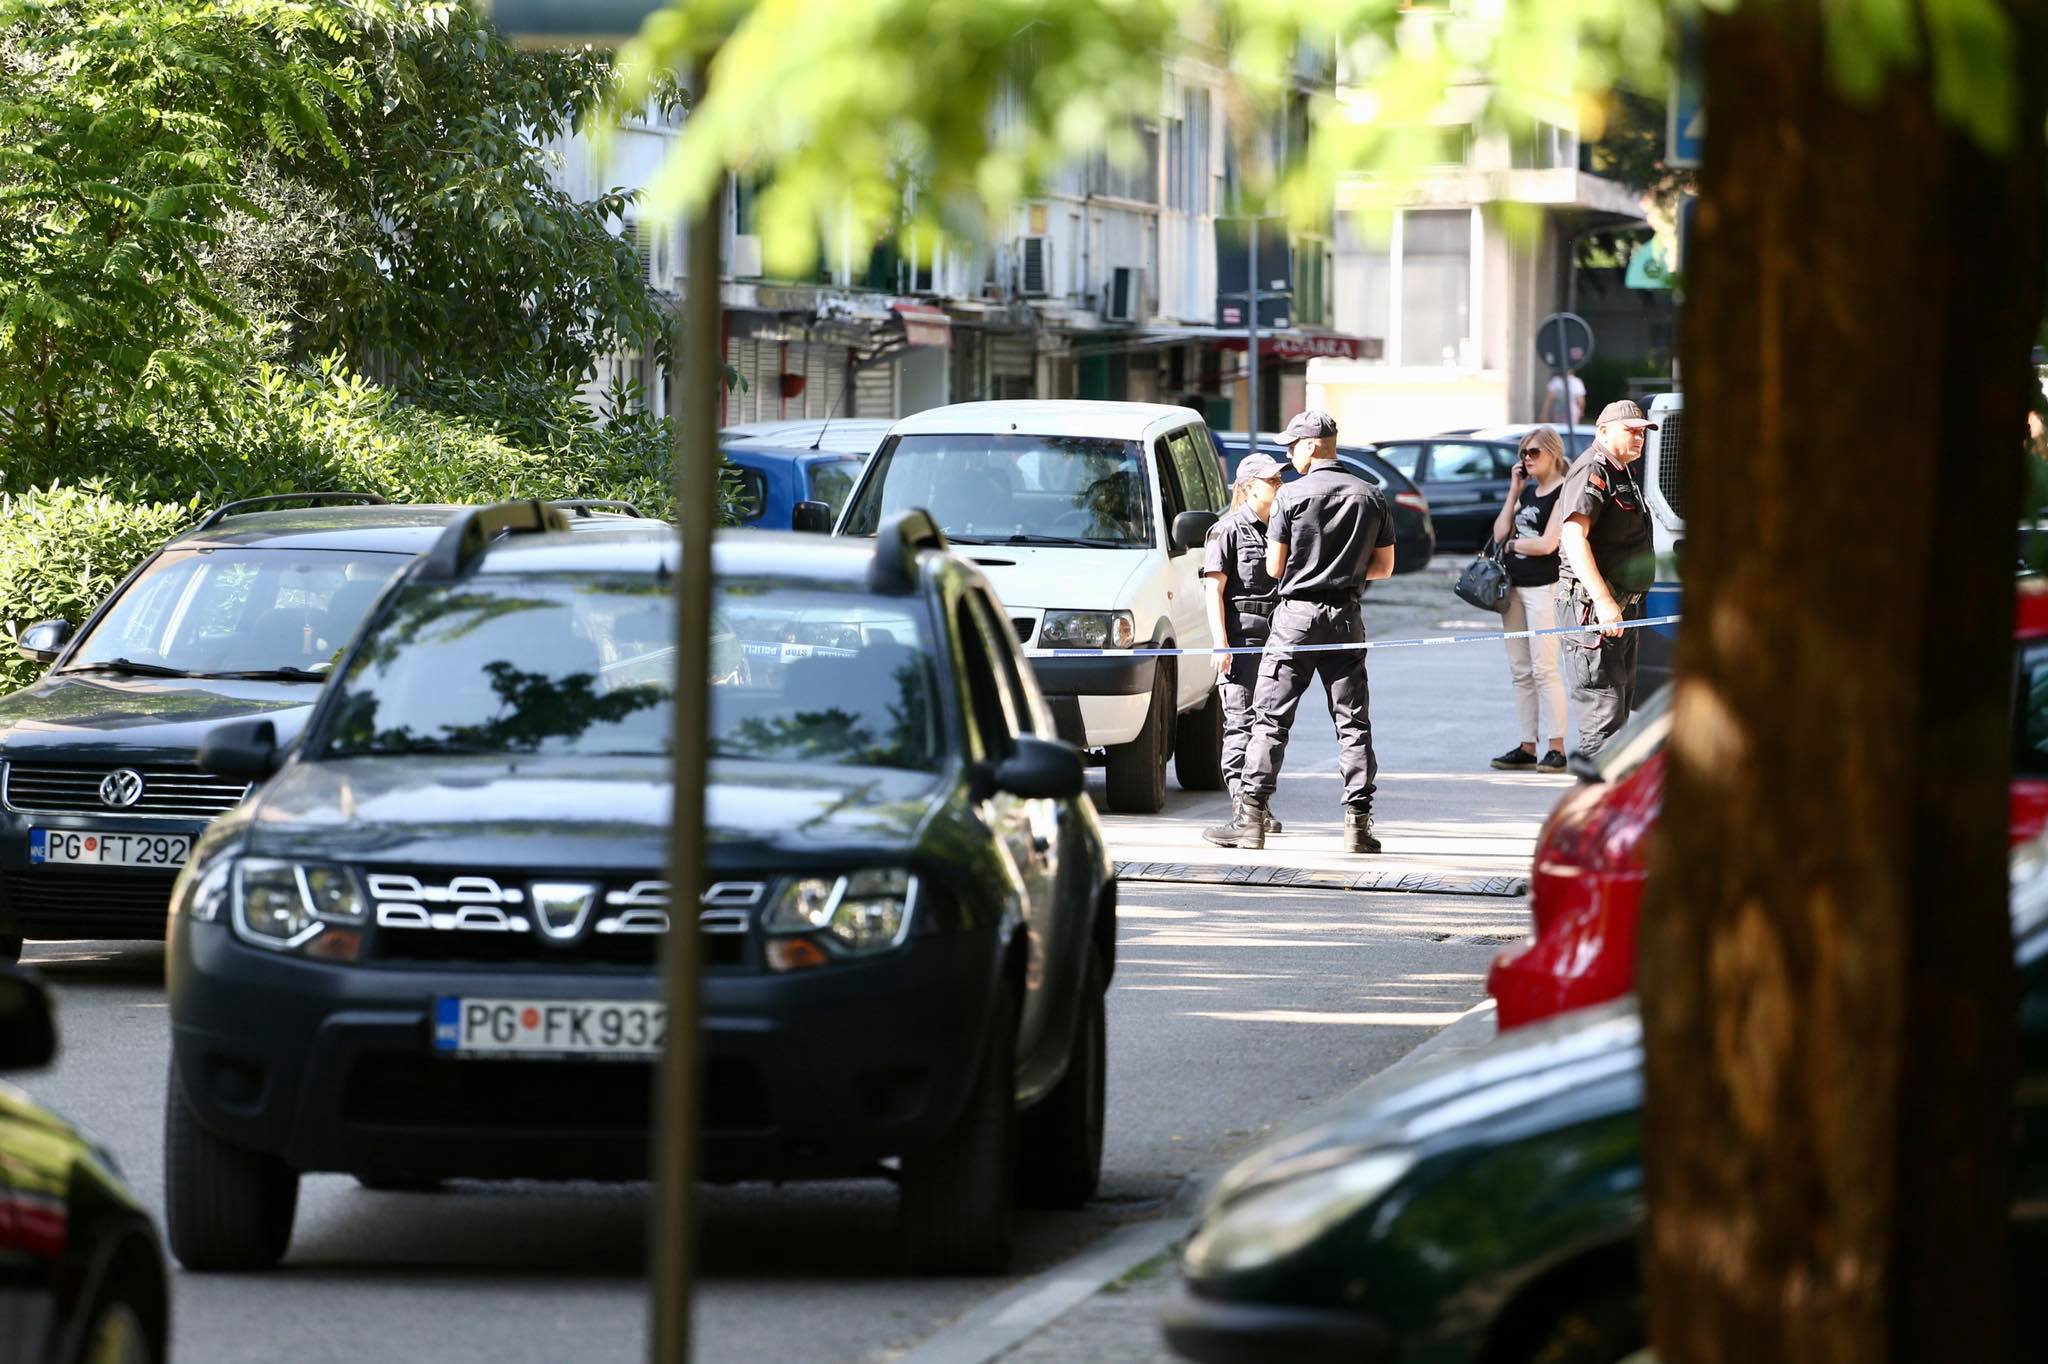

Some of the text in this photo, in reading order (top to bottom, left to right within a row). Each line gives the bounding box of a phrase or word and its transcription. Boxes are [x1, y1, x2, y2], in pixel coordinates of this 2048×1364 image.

[785, 648, 808, 658] STOP
[49, 833, 81, 860] PG
[465, 1004, 517, 1043] PG
